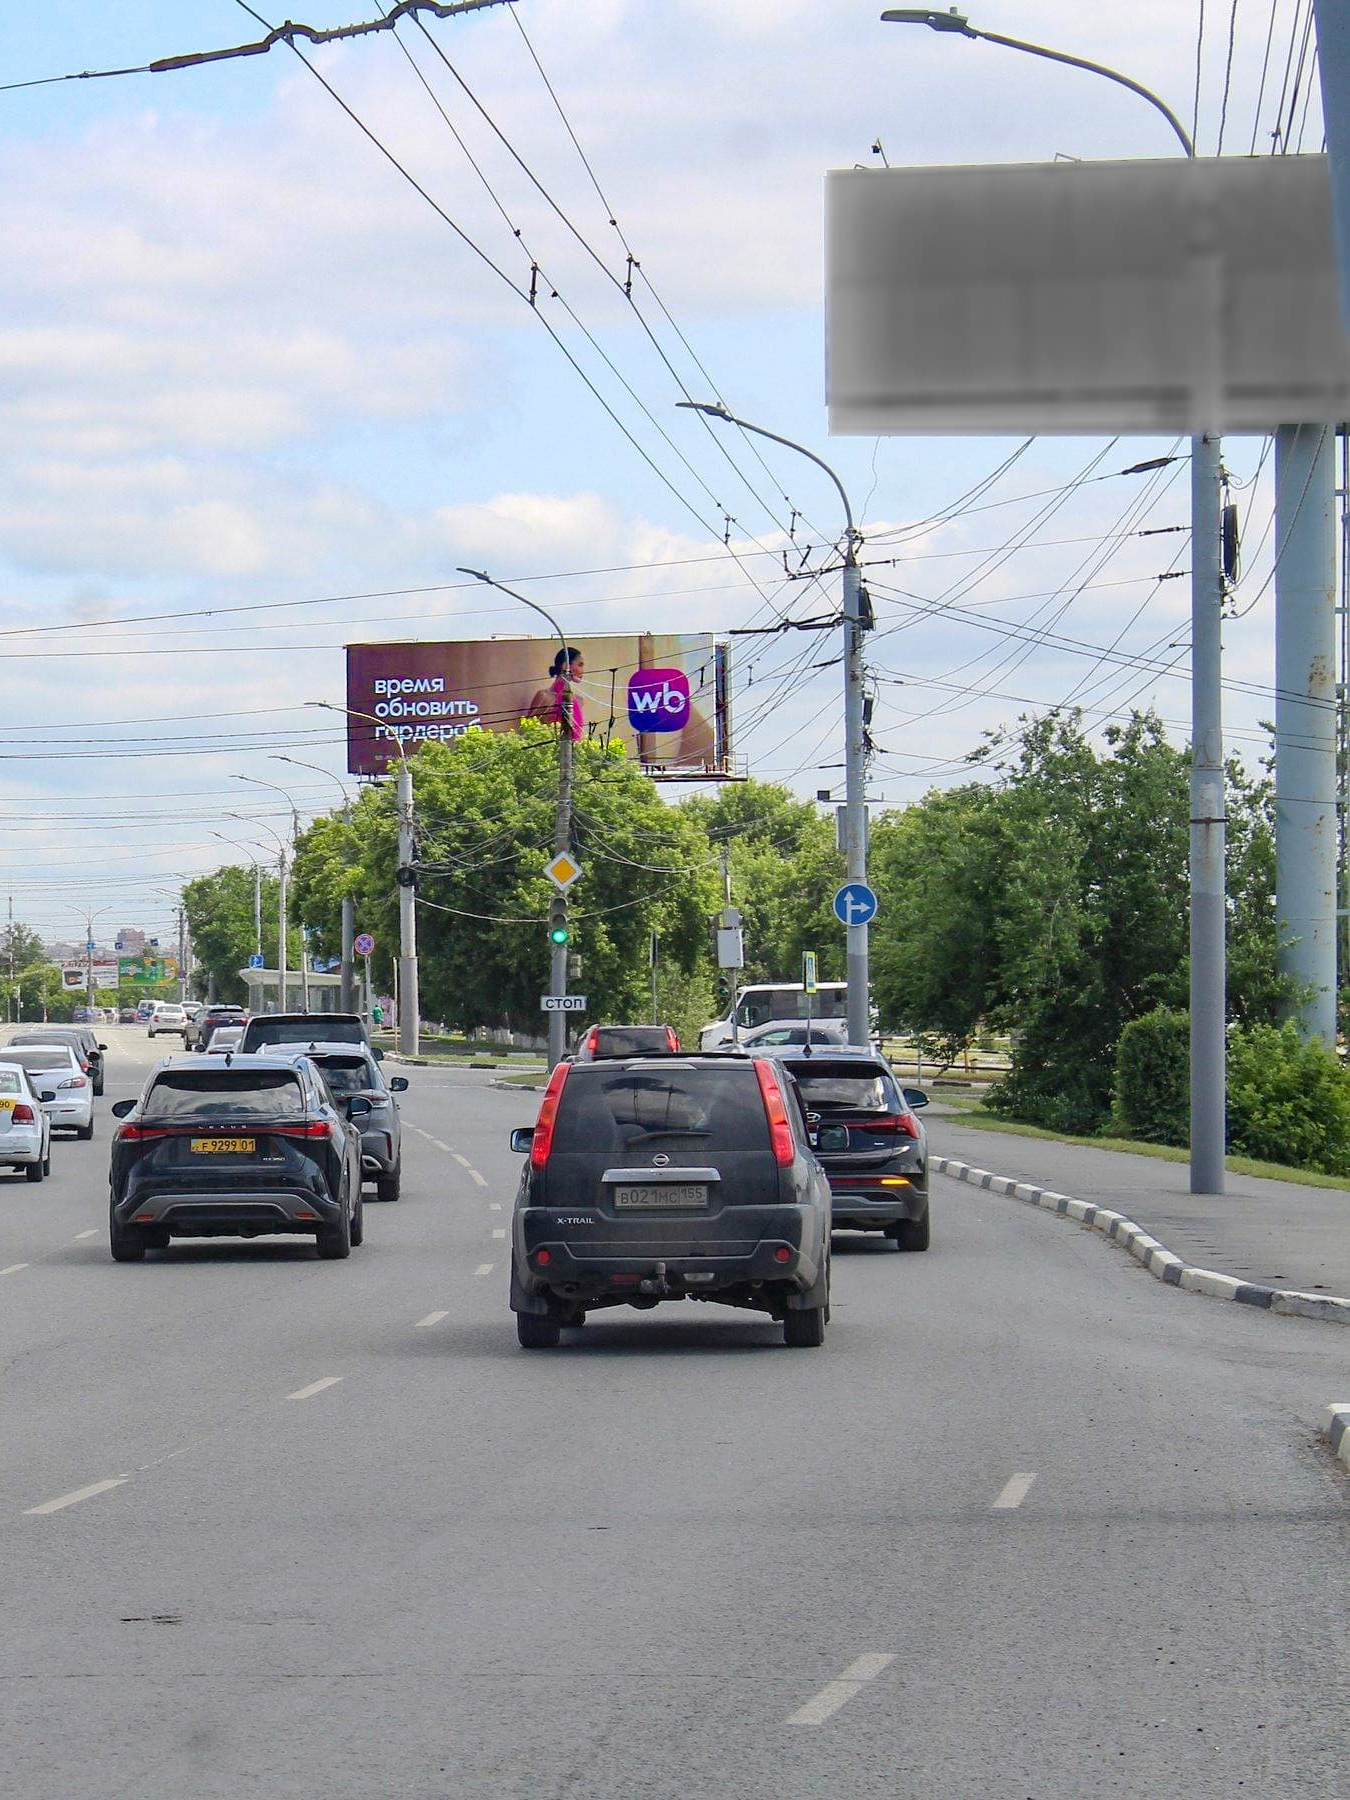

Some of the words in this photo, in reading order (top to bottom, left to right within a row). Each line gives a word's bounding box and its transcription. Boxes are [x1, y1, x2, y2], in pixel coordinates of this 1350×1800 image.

[374, 678, 444, 699] время
[631, 681, 686, 714] wb
[374, 697, 479, 718] обновить
[545, 998, 582, 1009] СТОП
[211, 1140, 237, 1151] 9299
[240, 1140, 255, 1151] 01
[556, 1217, 595, 1225] X-TRAIL
